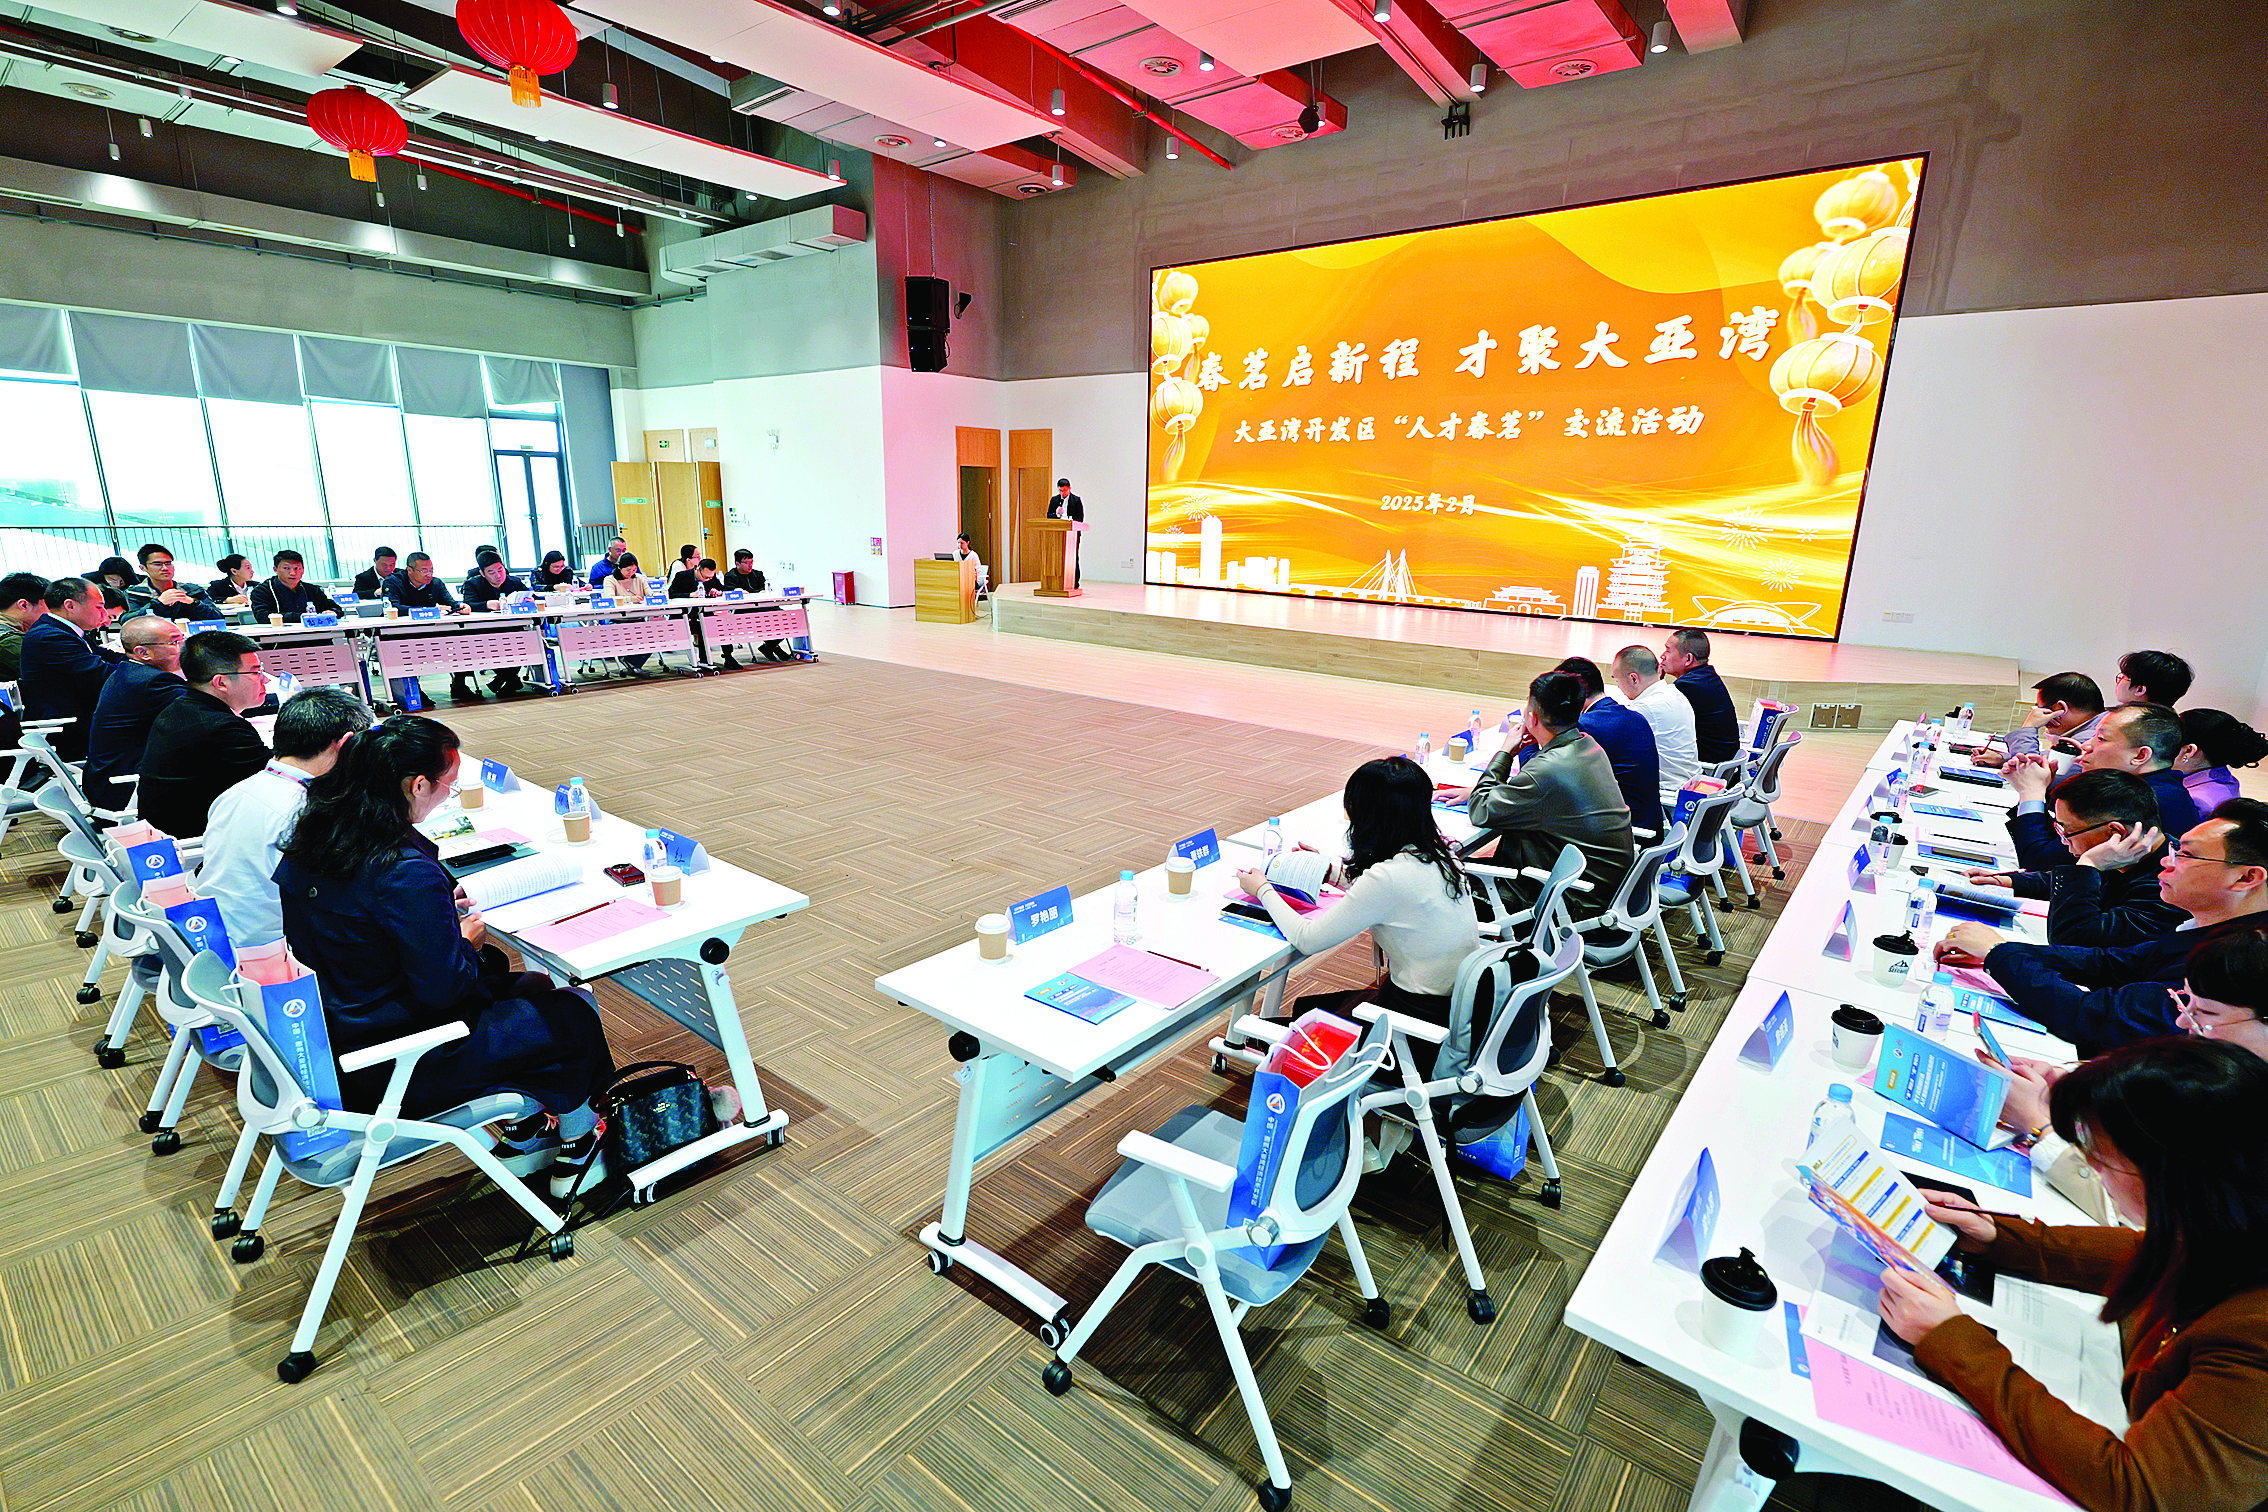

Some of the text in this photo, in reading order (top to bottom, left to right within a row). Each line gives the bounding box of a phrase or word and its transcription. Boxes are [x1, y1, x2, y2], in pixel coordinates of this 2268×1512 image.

[1197, 305, 1780, 391] 春茗启新程 才聚大亚湾
[1380, 492, 1476, 515] 2025年2月
